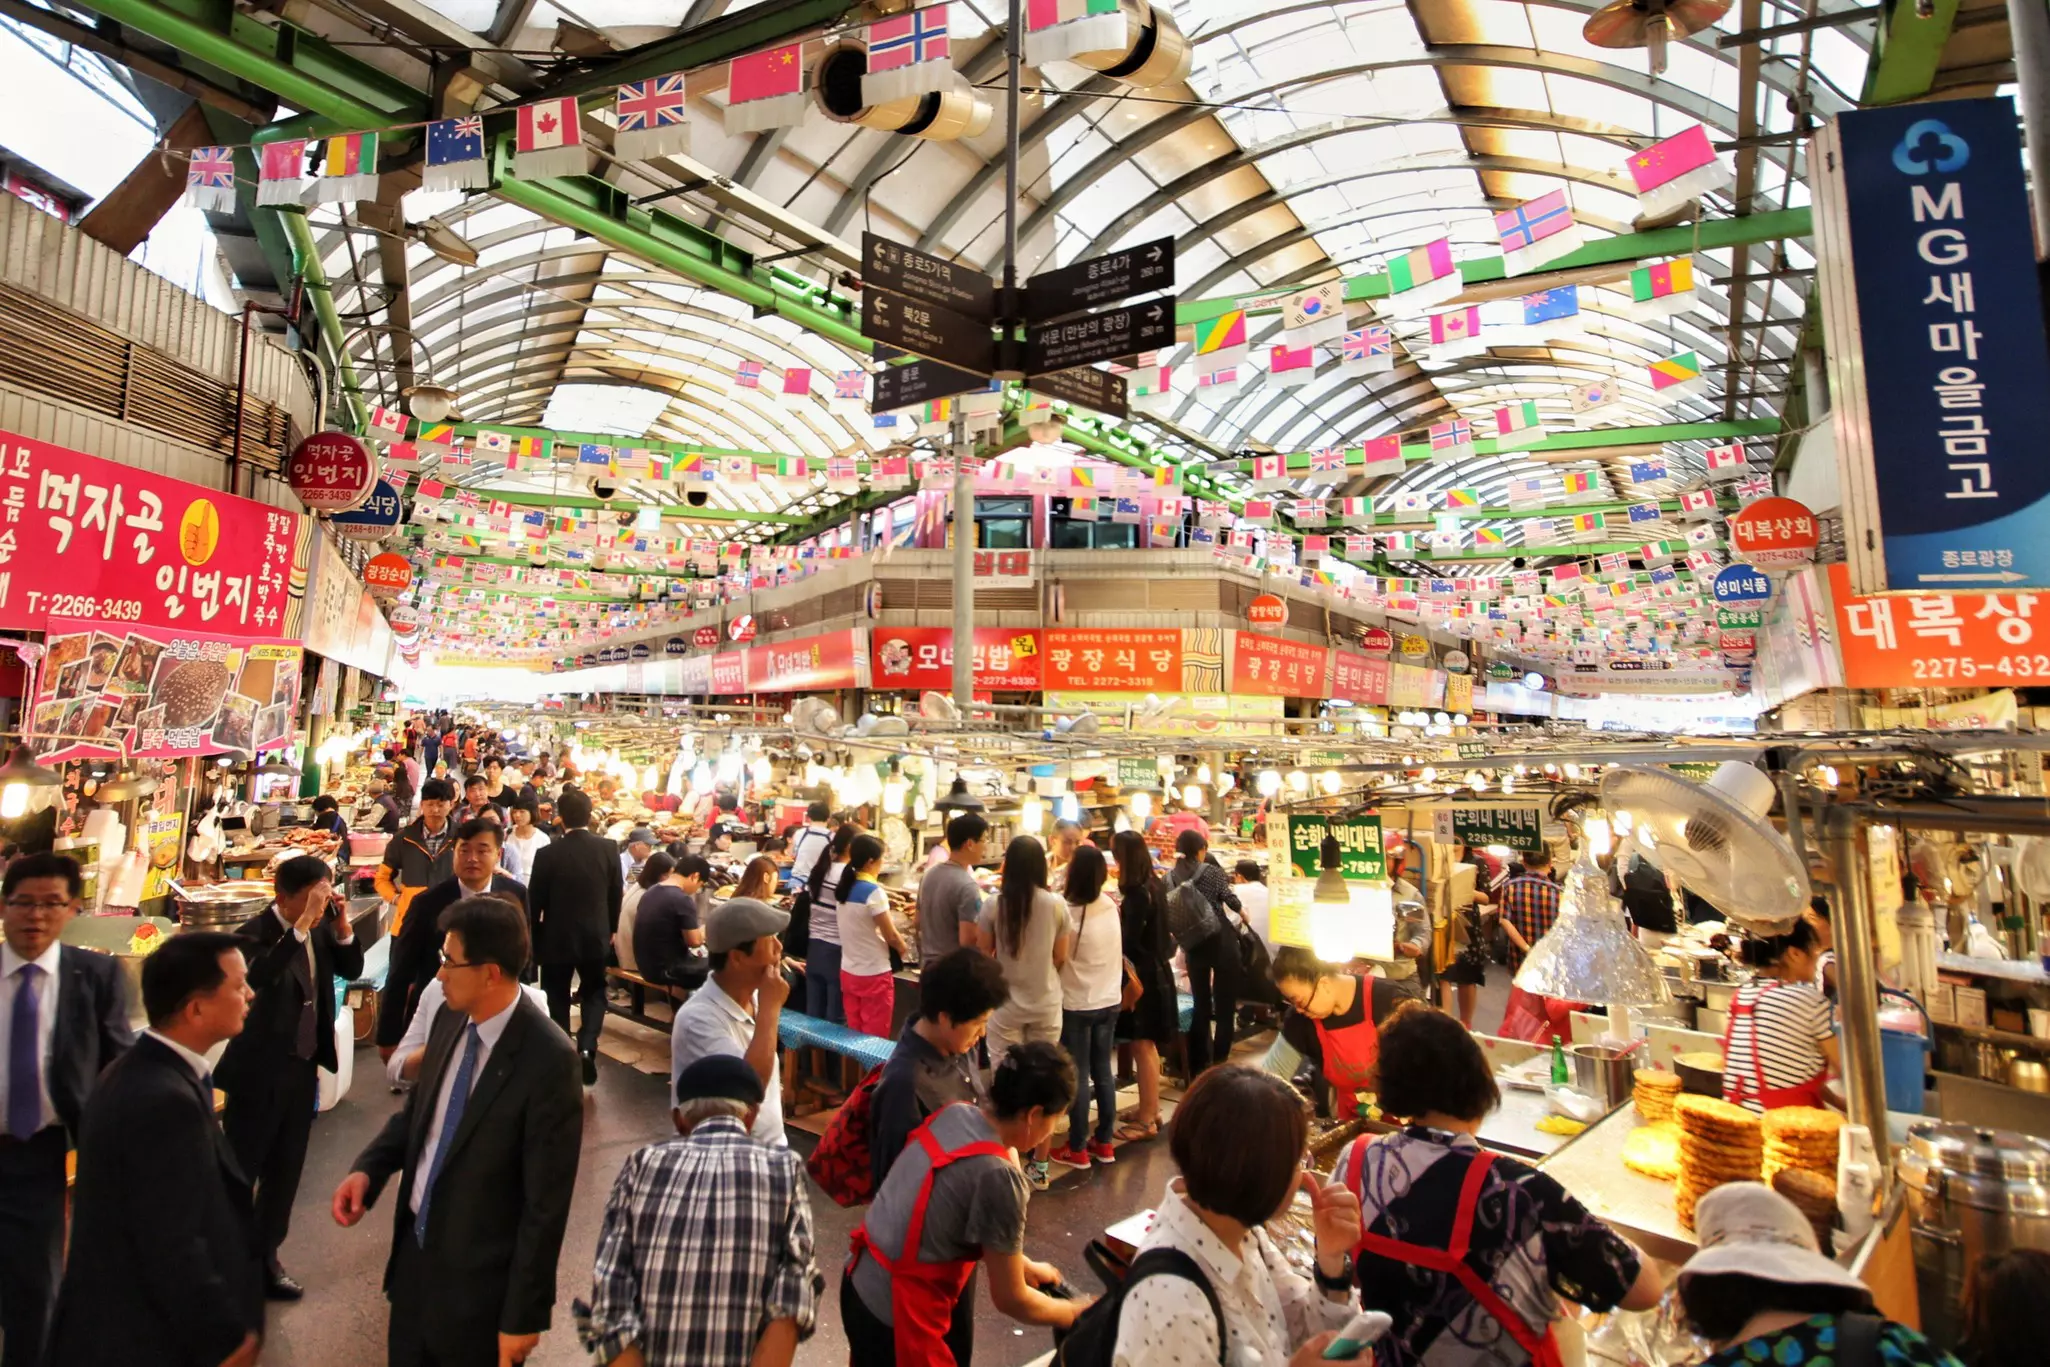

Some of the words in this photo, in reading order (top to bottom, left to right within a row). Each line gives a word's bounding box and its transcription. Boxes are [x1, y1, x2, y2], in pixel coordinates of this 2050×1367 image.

[903, 251, 951, 282] 종로5가역
[1087, 254, 1131, 279] 종로4가
[306, 443, 355, 462] 먹자골
[293, 463, 363, 487] 일번지
[301, 489, 353, 502] 2266-3439
[37, 468, 164, 565] 먹자골
[1736, 516, 1813, 542] 대복상회
[1755, 550, 1805, 564] 2275-4324
[1941, 549, 2014, 568] 종로광장
[367, 564, 410, 583] 광장순대
[155, 564, 253, 626] 일번지
[1716, 577, 1768, 597] 성미식품
[1050, 647, 1175, 673] 광장식당
[1248, 656, 1316, 685] 광장식당
[167, 727, 202, 750] 먹는날
[1454, 808, 1493, 828] 순희네
[1496, 808, 1537, 832] 빈대떡
